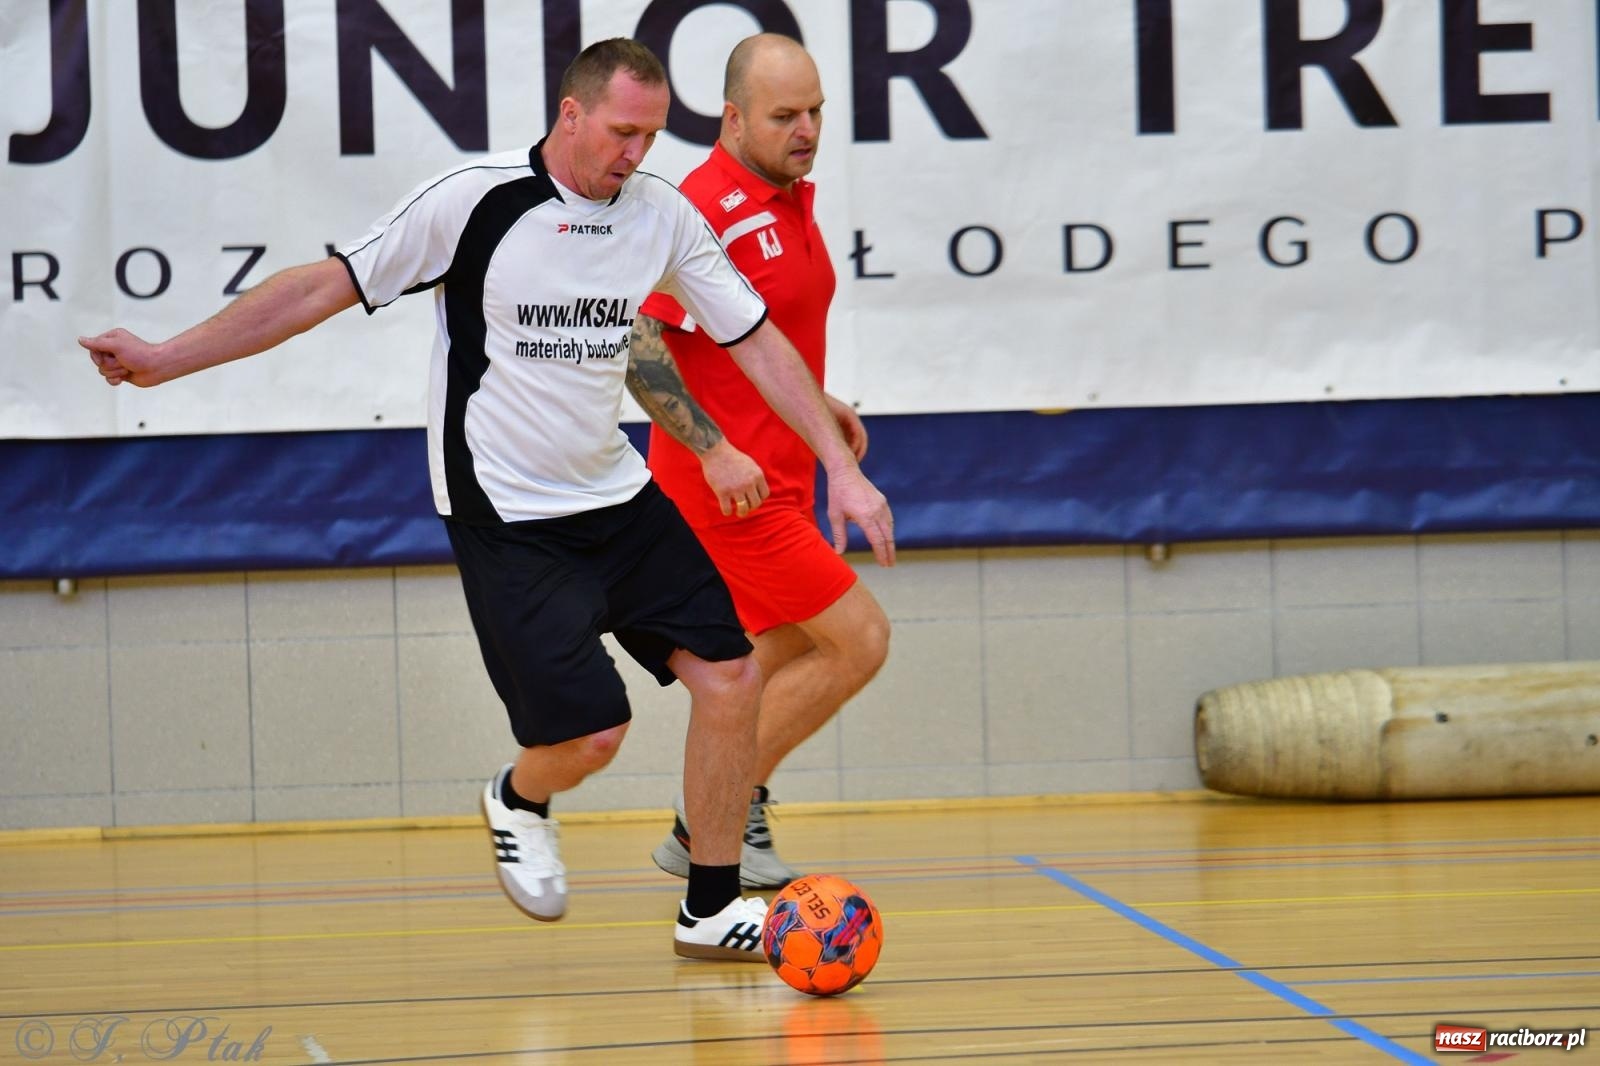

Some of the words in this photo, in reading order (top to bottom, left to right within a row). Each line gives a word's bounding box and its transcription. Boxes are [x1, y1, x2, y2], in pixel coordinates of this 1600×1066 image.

[8, 0, 990, 165] JUNIOR
[1135, 0, 1600, 135] TRE
[570, 224, 614, 235] PATRICK
[756, 227, 784, 261] KJ
[848, 211, 1421, 281] ŁODEGO
[517, 298, 635, 328] www.IKSAL.
[515, 337, 583, 365] materiały
